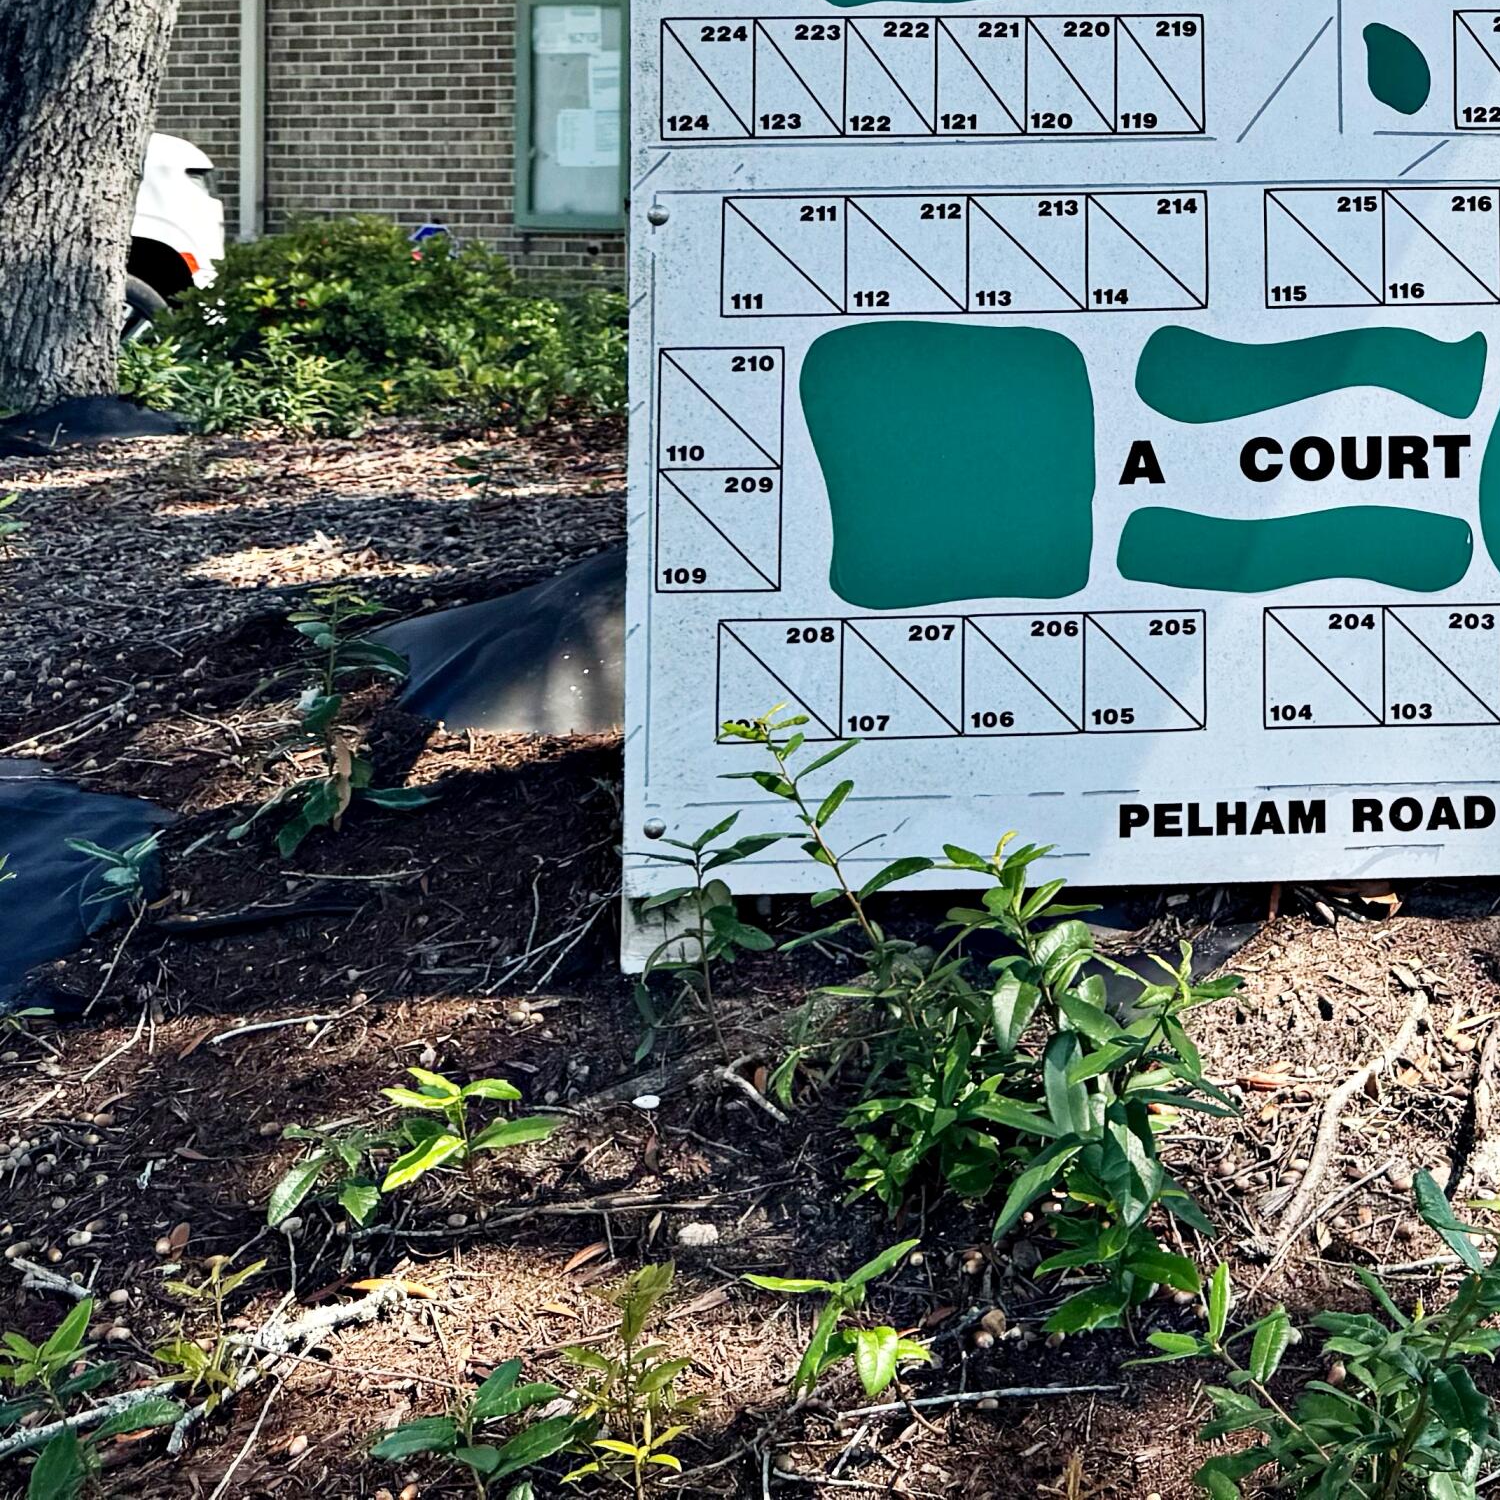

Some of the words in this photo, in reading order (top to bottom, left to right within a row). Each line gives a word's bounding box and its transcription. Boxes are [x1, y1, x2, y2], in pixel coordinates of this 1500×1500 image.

[700, 25, 748, 42] 224
[794, 23, 841, 41] 223
[883, 21, 930, 39] 222
[977, 21, 1019, 38] 221
[1063, 21, 1111, 38] 220
[1155, 20, 1197, 37] 219
[667, 114, 710, 132] 124
[759, 113, 802, 130] 123
[849, 115, 891, 132] 122
[940, 113, 977, 130] 121
[1030, 112, 1073, 130] 120
[1120, 112, 1158, 129] 119
[920, 203, 962, 220] 212
[1038, 199, 1079, 217] 213
[1156, 197, 1198, 215] 214
[1337, 195, 1378, 213] 215
[1451, 195, 1493, 212] 216
[799, 205, 837, 222] 211
[853, 290, 890, 308] 112
[975, 290, 1012, 307] 113
[1092, 288, 1129, 305] 114
[1271, 285, 1308, 302] 115
[1388, 282, 1425, 299] 116
[730, 293, 763, 310] 111
[731, 355, 775, 373] 210
[665, 445, 705, 462] 110
[1118, 440, 1166, 486] A
[1239, 434, 1471, 483] COURT
[724, 476, 774, 494] 209
[662, 567, 707, 585] 109
[1030, 620, 1079, 637] 206
[1149, 618, 1197, 636] 205
[1328, 613, 1376, 630] 204
[1448, 612, 1495, 631] 203
[786, 626, 835, 644] 208
[908, 624, 956, 642] 207
[970, 711, 1015, 729] 106
[1091, 707, 1135, 725] 105
[1270, 704, 1313, 722] 104
[1390, 703, 1433, 720] 103
[847, 714, 890, 732] 107
[1119, 799, 1326, 839] PELHAM
[1352, 795, 1496, 833] ROAD
